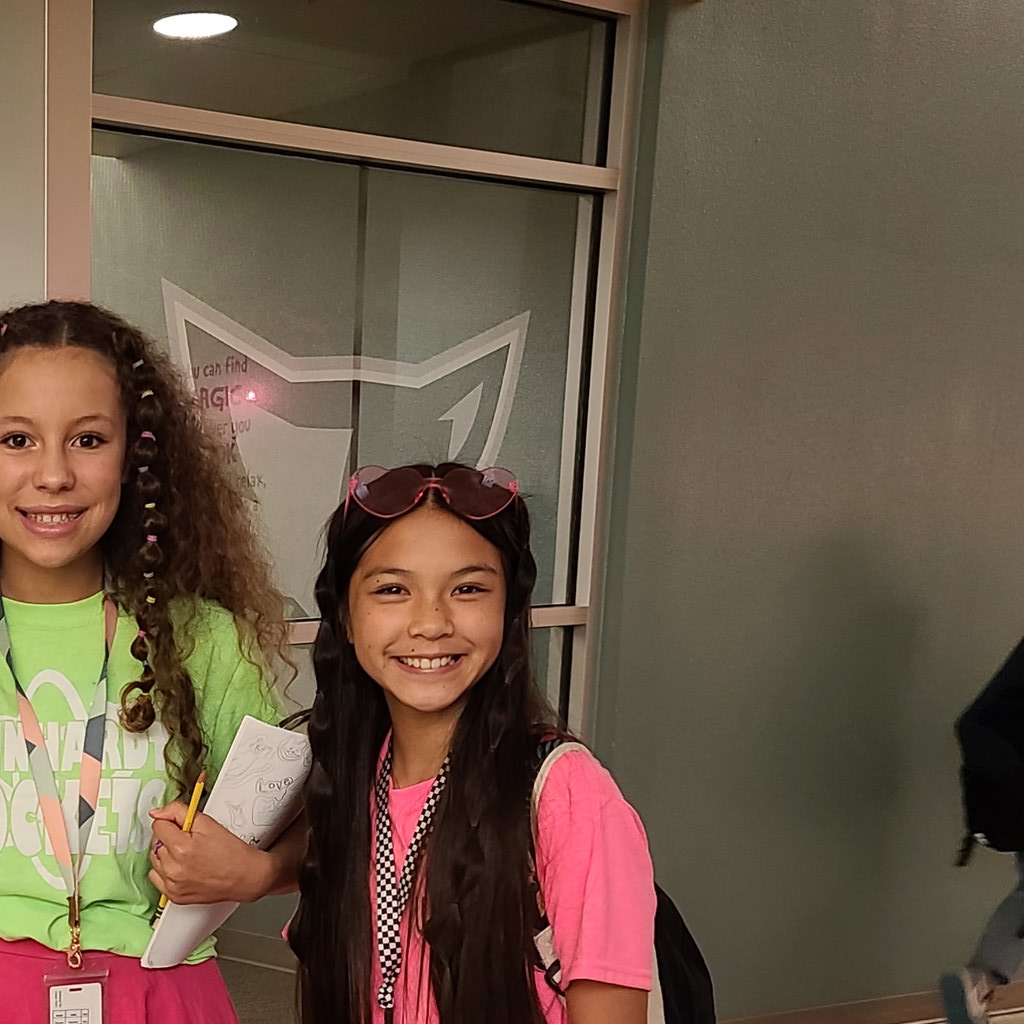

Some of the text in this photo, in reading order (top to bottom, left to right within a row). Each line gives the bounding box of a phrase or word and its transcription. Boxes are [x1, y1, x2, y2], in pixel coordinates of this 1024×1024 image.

[203, 363, 222, 377] can
[225, 355, 248, 374] find
[199, 385, 243, 411] AGIC
